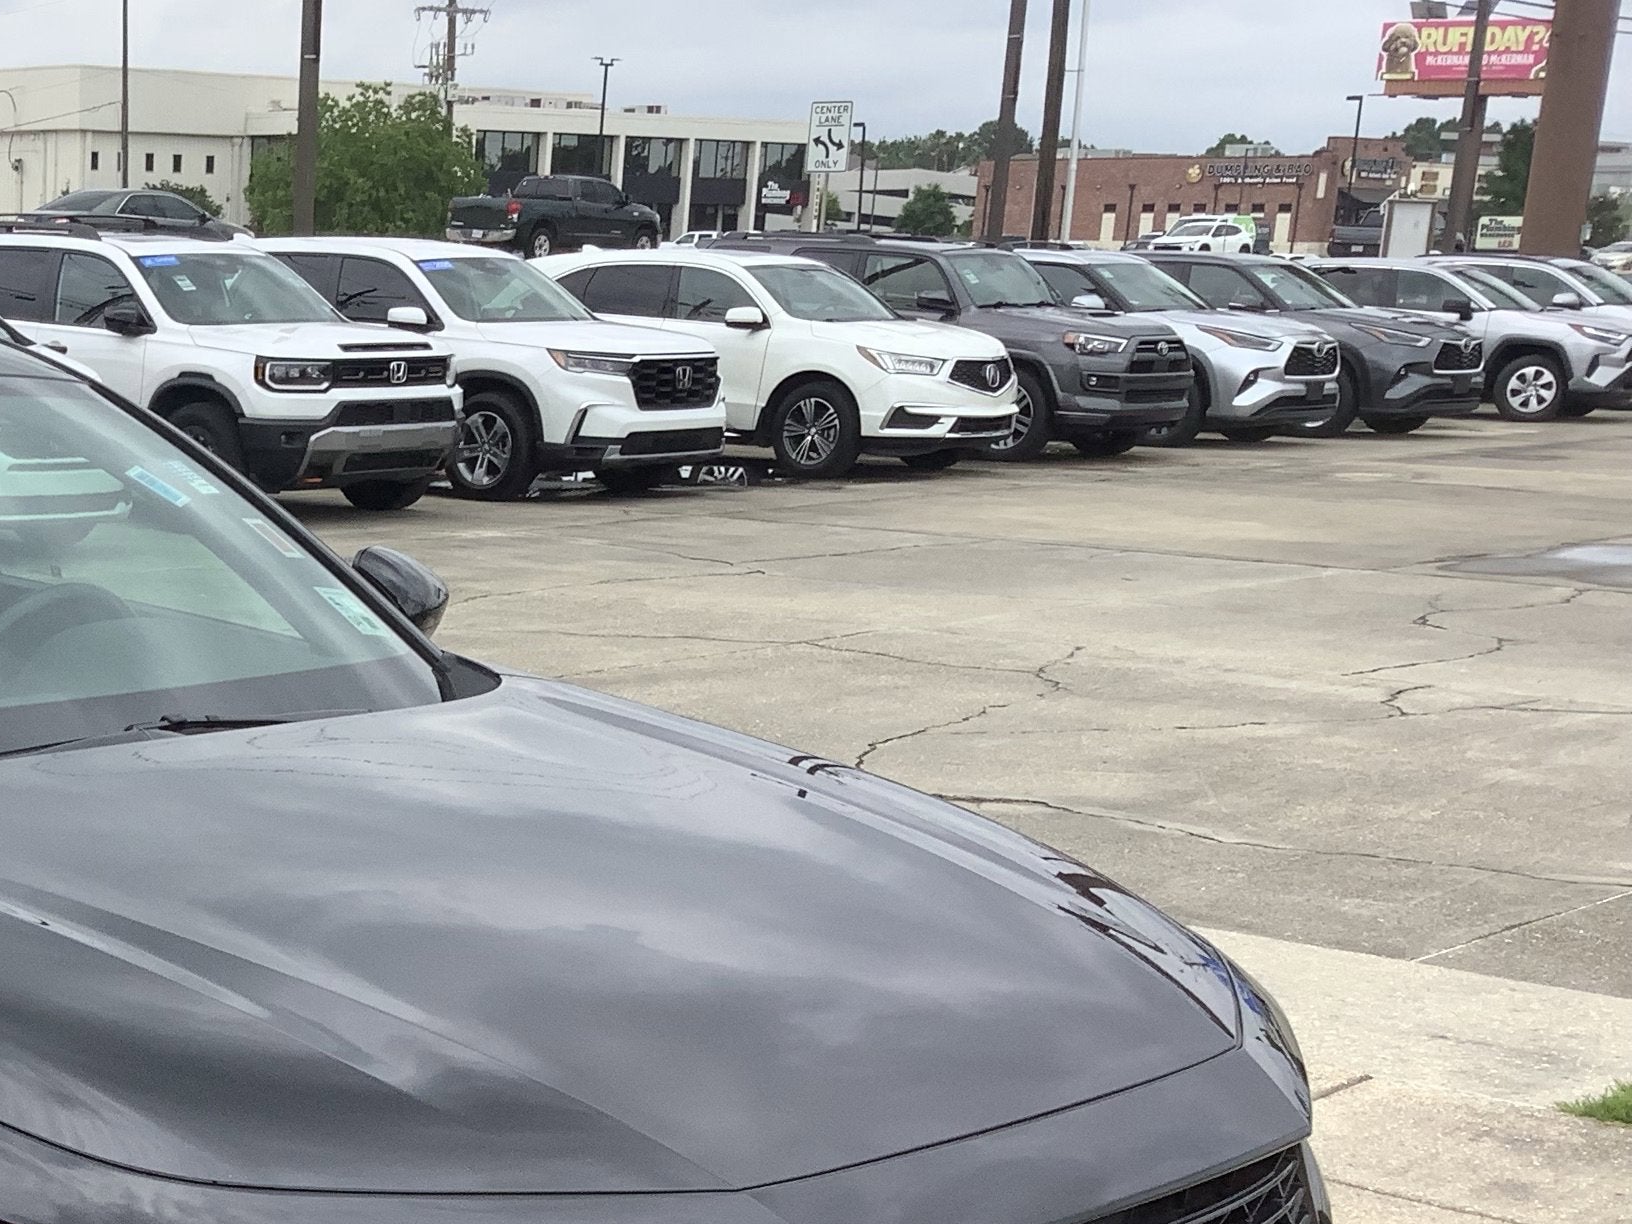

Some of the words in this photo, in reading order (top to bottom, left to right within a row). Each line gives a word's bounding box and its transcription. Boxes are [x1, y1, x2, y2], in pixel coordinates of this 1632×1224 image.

[1484, 25, 1546, 52] DAY?
[814, 105, 849, 114] CENTER
[818, 115, 843, 124] LANE
[814, 159, 839, 169] ONLY
[1207, 163, 1271, 176] DUMPING
[1286, 163, 1313, 176] BAO
